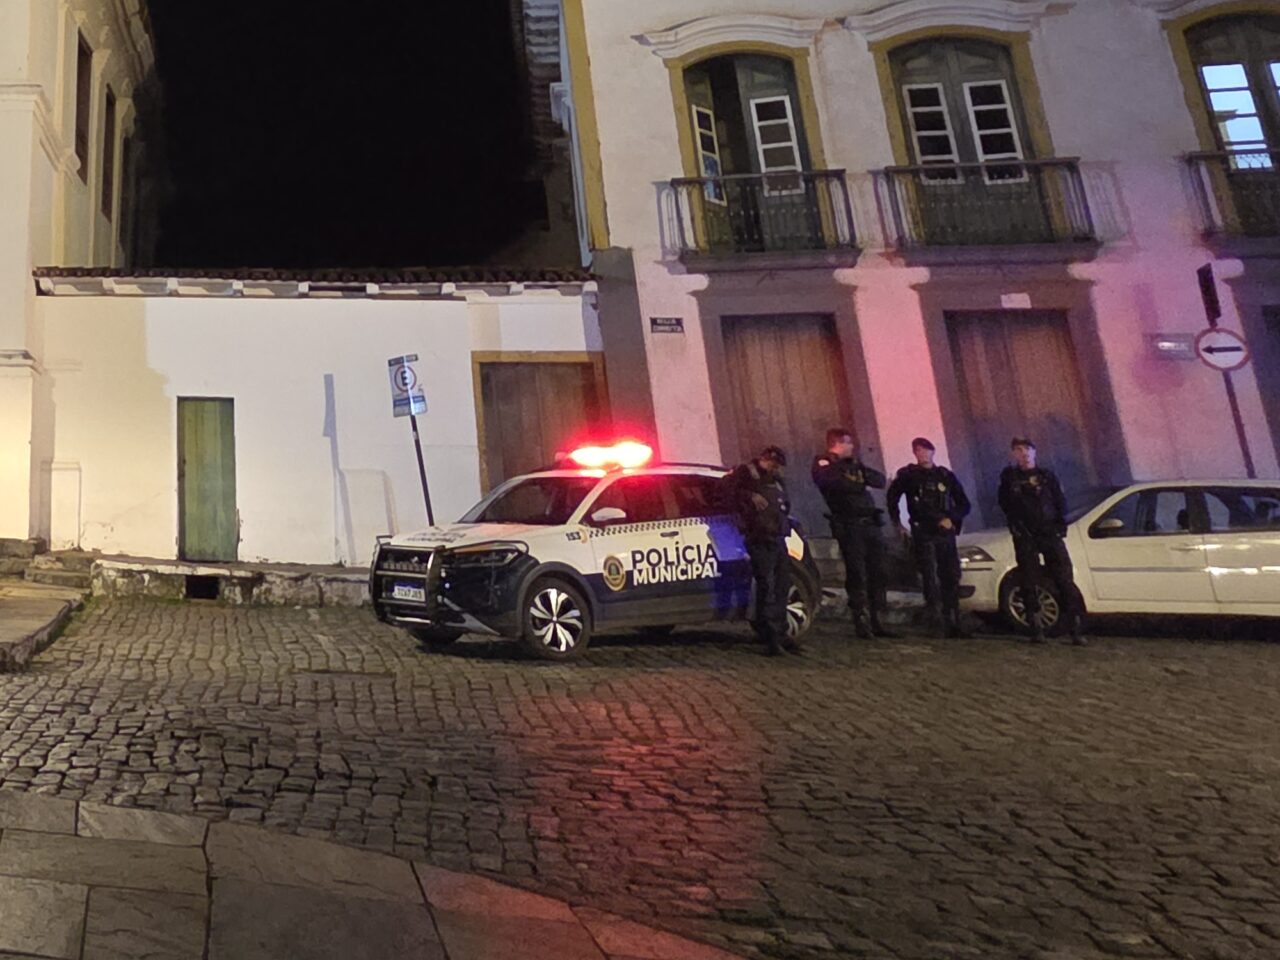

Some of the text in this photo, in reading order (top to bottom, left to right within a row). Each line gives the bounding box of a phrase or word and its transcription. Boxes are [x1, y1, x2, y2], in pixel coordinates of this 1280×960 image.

[565, 531, 581, 541] 153
[631, 542, 718, 569] POLÍCIA
[633, 558, 722, 586] MUNICIPAL
